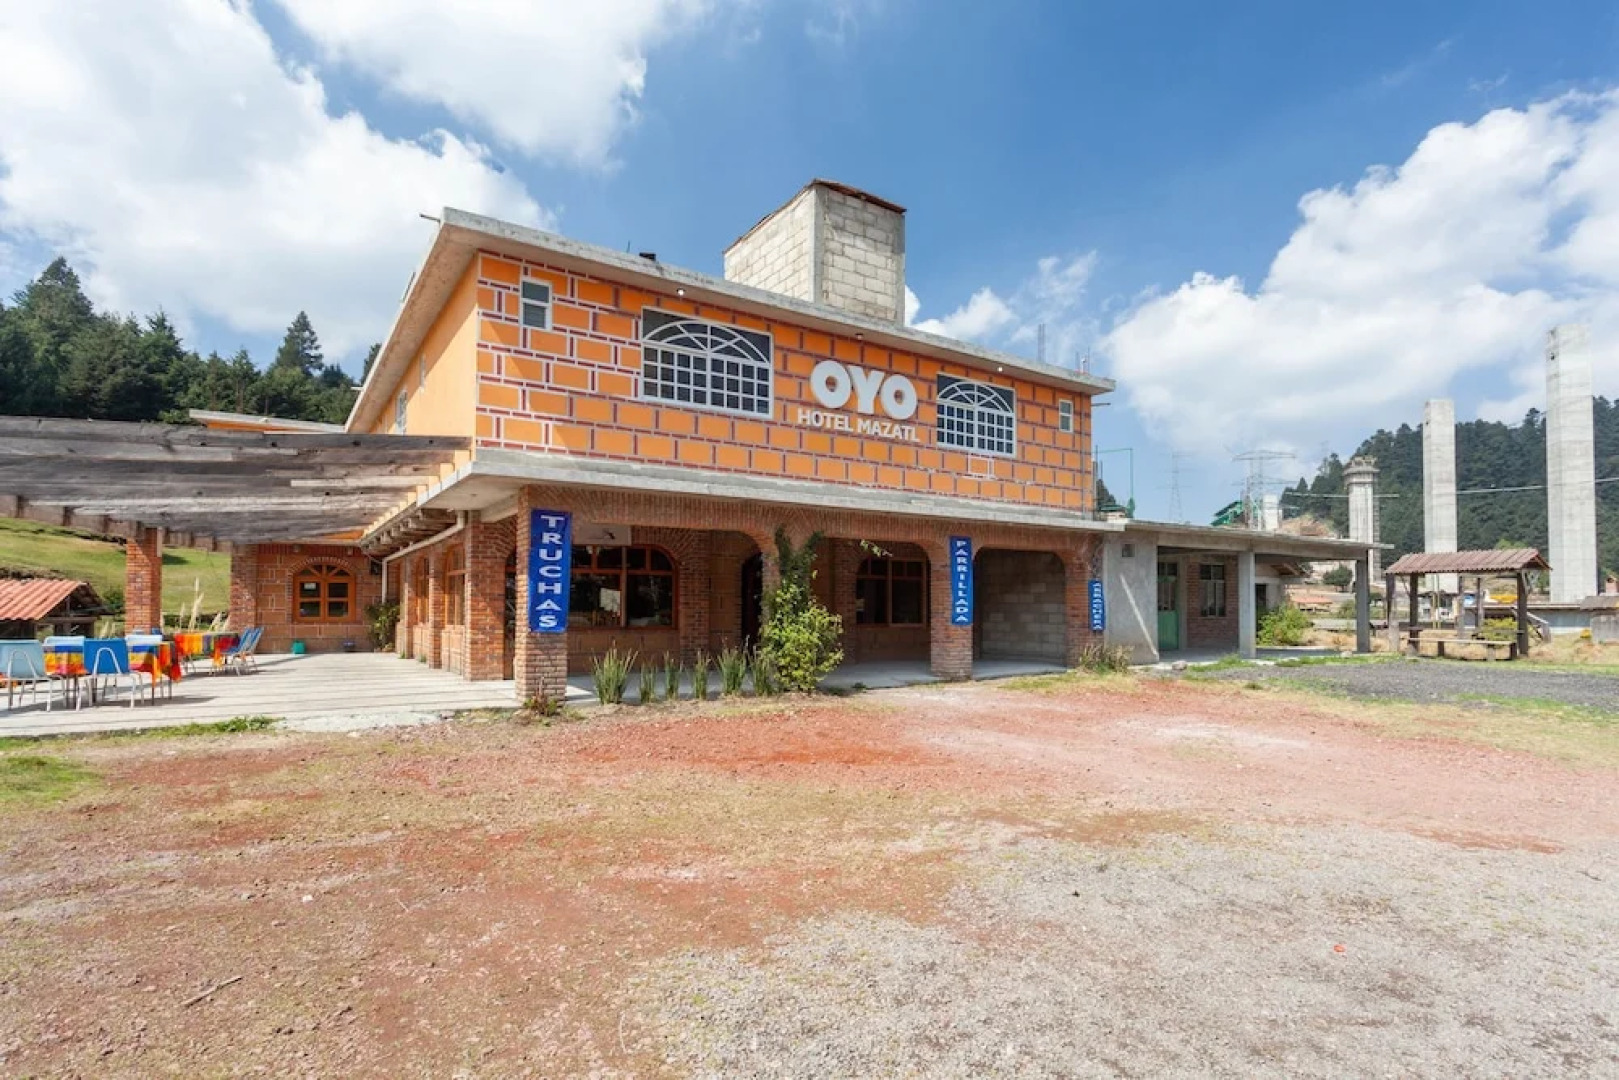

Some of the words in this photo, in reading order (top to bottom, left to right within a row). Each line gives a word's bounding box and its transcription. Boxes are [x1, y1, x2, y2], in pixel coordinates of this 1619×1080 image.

[797, 407, 854, 433] HOTEL
[857, 417, 920, 442] MAZATL
[810, 360, 918, 420] OYO
[535, 514, 565, 628] TRUCHAS
[954, 540, 969, 623] PARRILLADA
